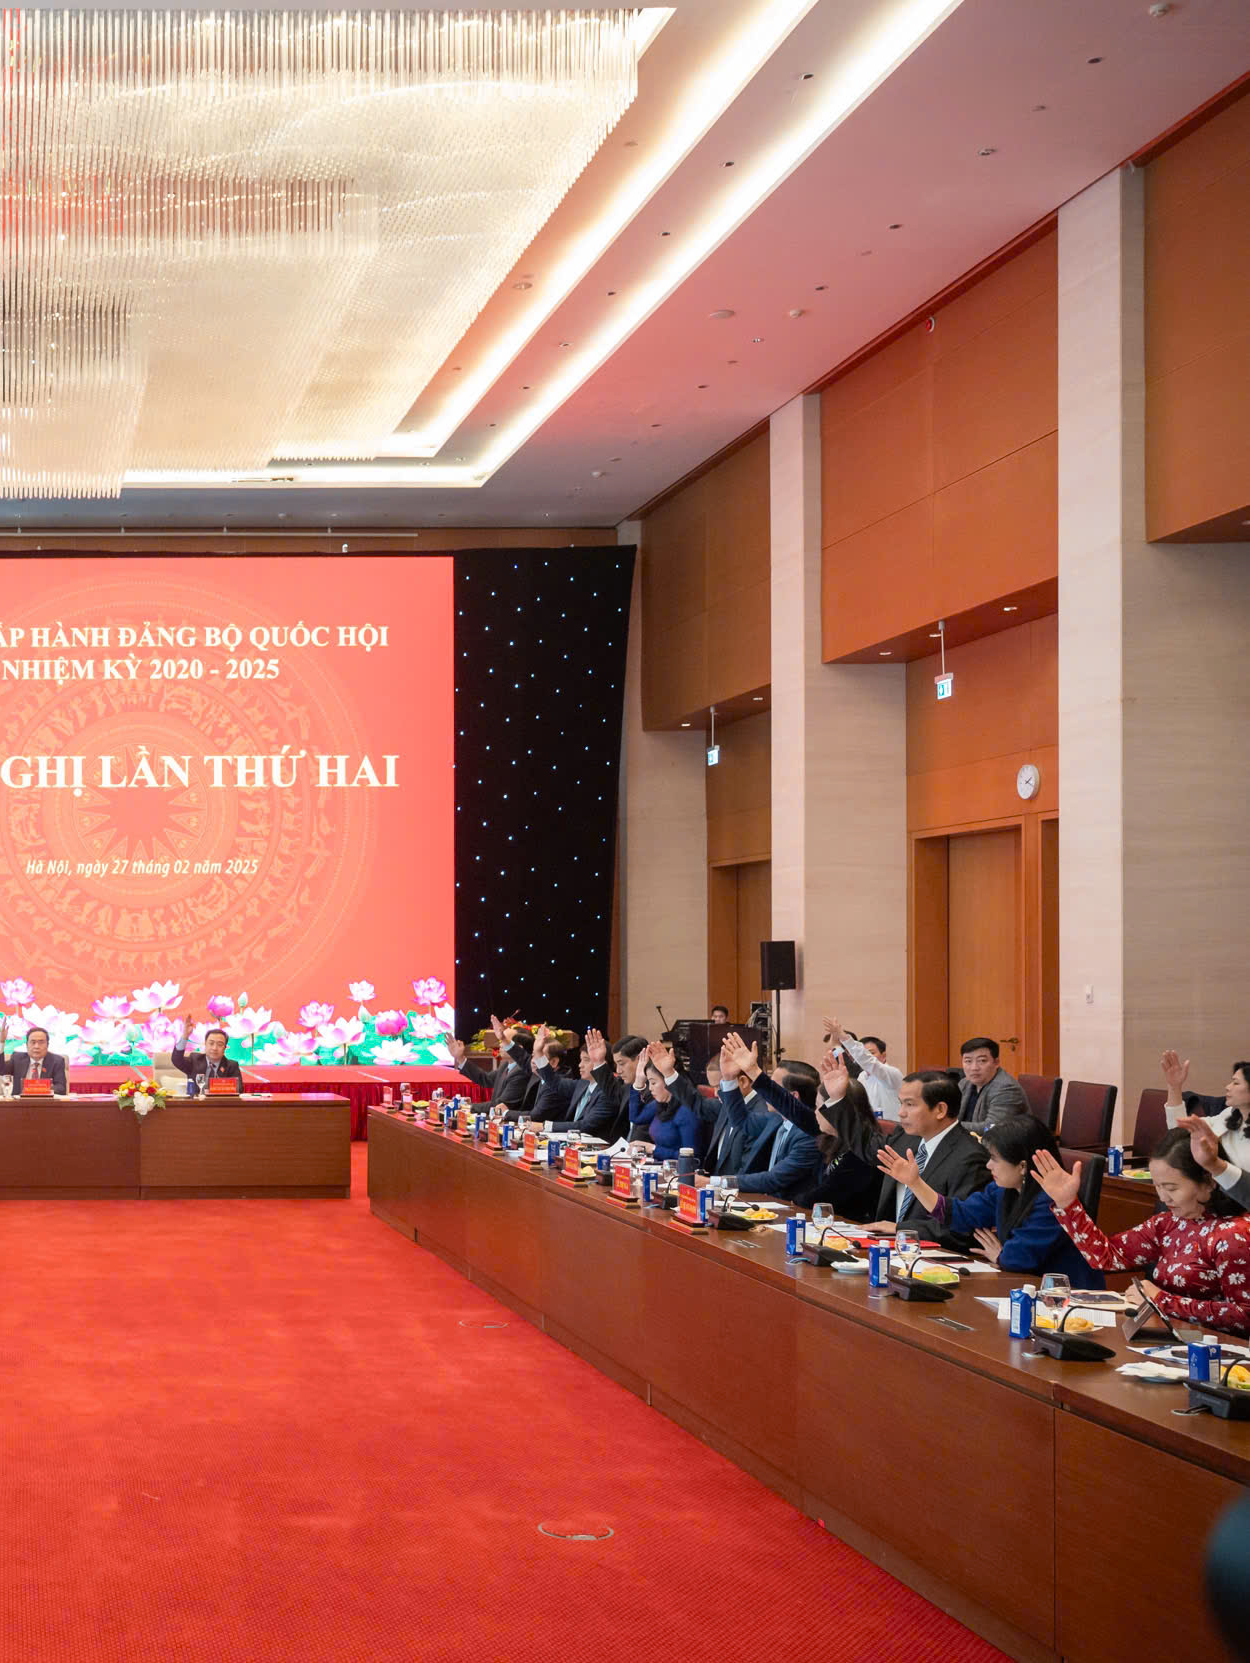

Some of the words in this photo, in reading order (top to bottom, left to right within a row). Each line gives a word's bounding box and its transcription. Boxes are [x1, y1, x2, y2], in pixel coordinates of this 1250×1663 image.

[30, 622, 111, 648] HÀNH
[117, 622, 197, 648] ĐẢNG
[204, 623, 243, 652] BỘ
[249, 621, 330, 652] QUỐC
[337, 623, 389, 652] HỘI
[1, 656, 95, 686] NHIỆM
[103, 653, 143, 680] KỲ
[149, 658, 204, 680] 2020
[226, 658, 280, 680] 2025
[98, 746, 192, 788] LẦN
[203, 745, 307, 788] THỨ
[316, 754, 399, 788] HAI
[25, 859, 44, 875] Hà
[47, 859, 72, 878] Nội,
[76, 859, 109, 878] ngày
[111, 859, 129, 875] 27
[132, 859, 171, 878] tháng
[173, 859, 191, 875] 02
[193, 859, 223, 875] năm
[225, 859, 259, 875] 2025
